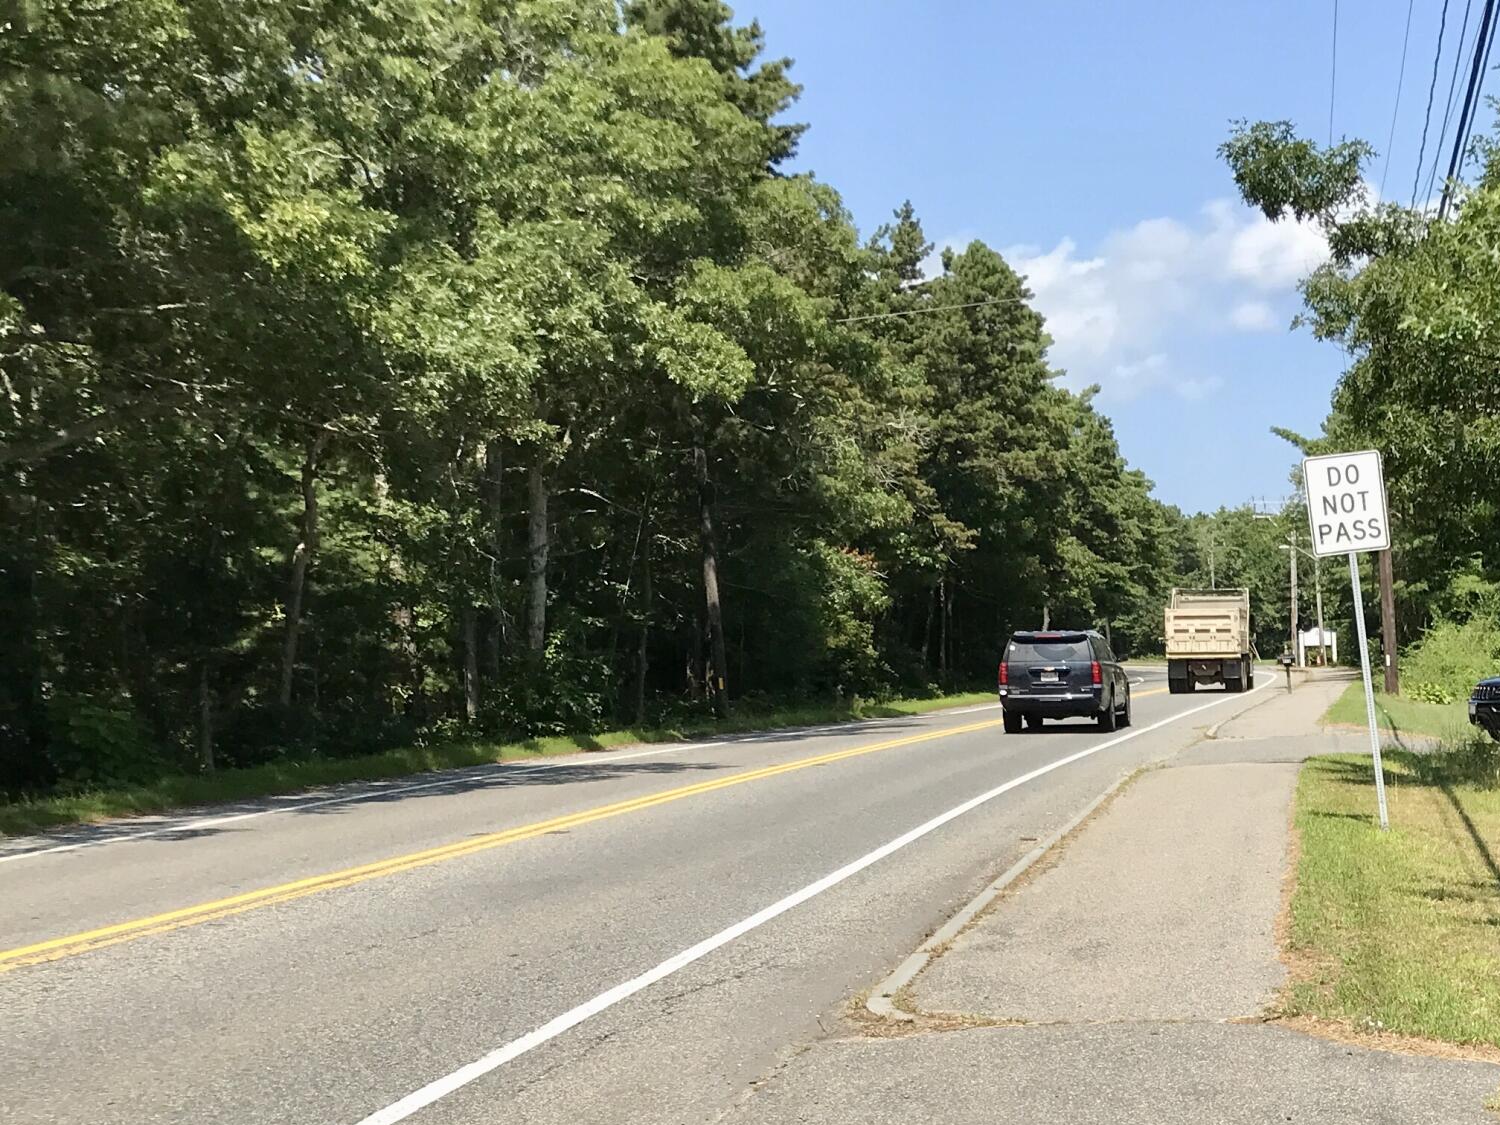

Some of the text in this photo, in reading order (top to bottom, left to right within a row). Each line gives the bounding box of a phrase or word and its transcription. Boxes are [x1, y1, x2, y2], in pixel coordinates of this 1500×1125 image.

[1327, 464, 1359, 487] DO
[1322, 491, 1369, 516] NOT
[1318, 518, 1381, 545] PASS
